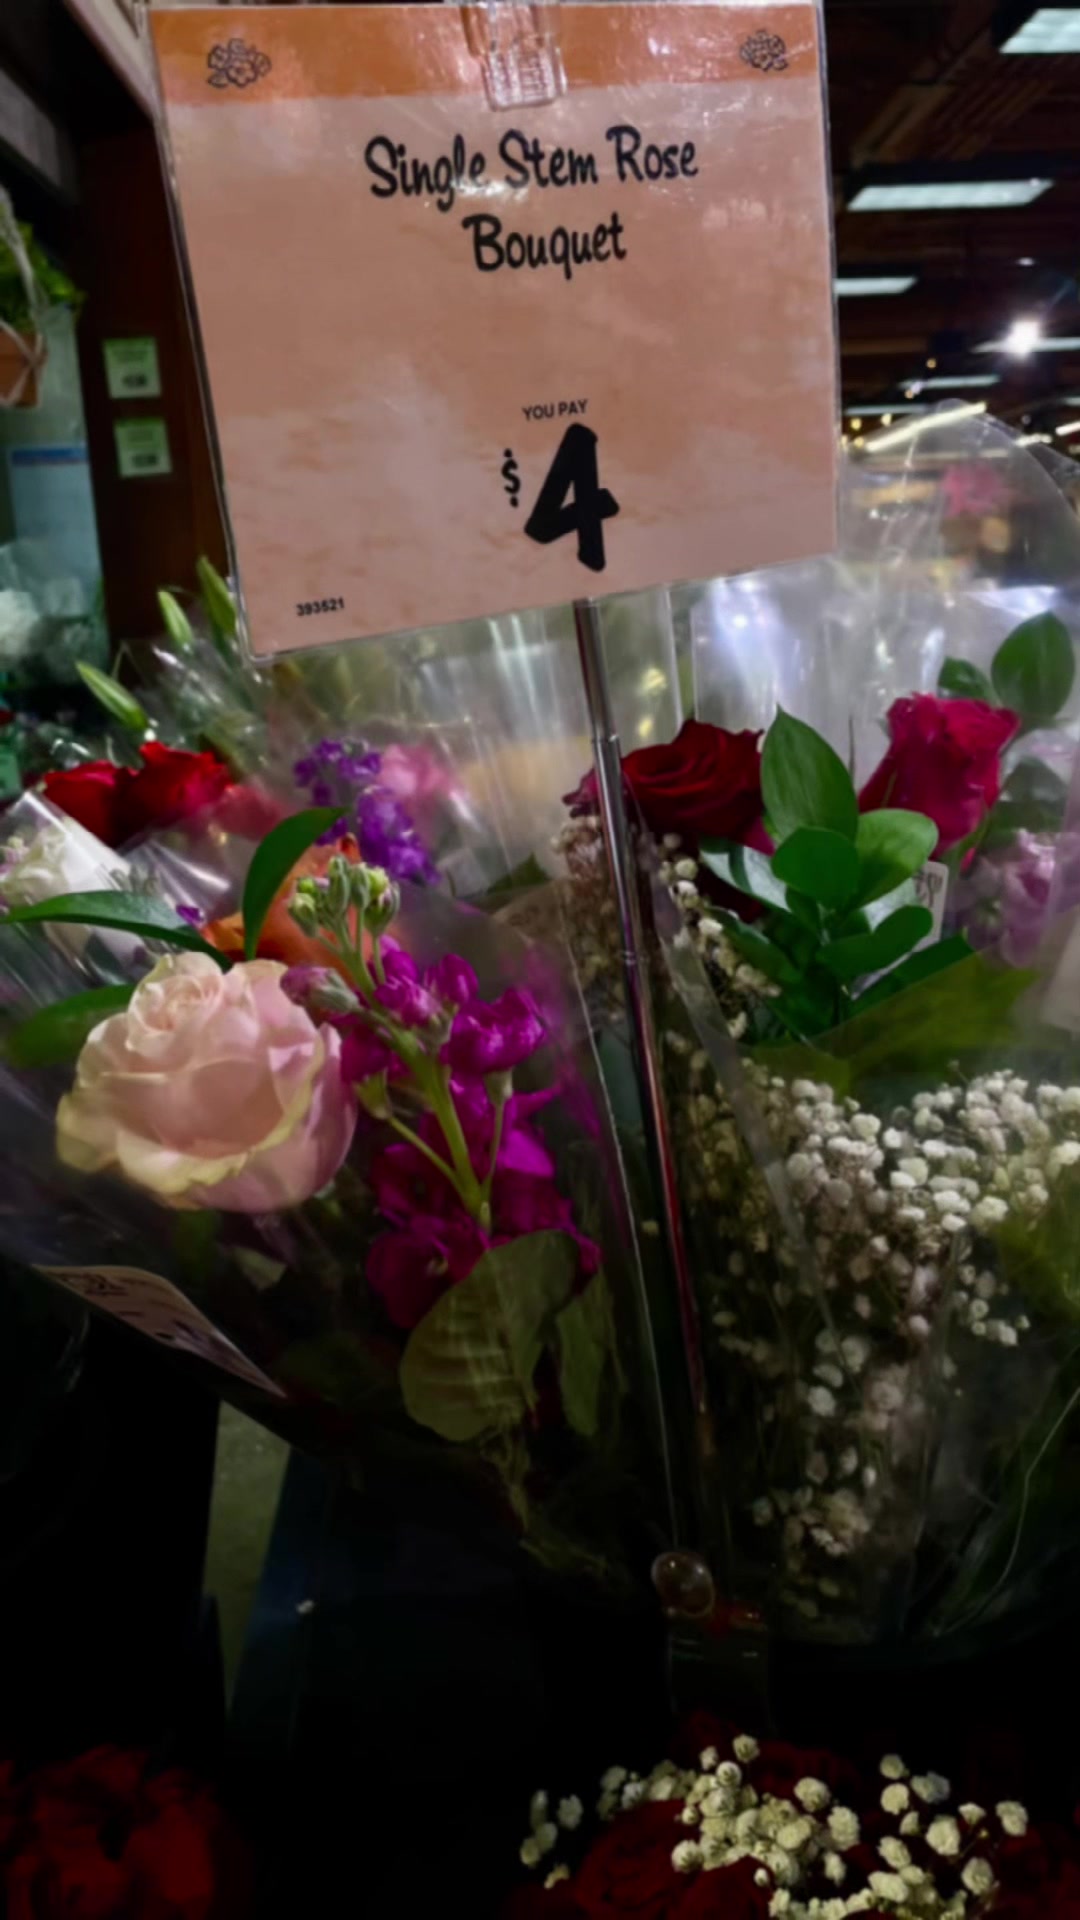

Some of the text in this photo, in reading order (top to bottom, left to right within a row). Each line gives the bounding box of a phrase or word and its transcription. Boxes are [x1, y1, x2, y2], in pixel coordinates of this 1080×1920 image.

[363, 124, 699, 213] Single Stem Rose
[460, 211, 628, 281] Bouquet
[521, 399, 589, 421] YOU PAY
[295, 596, 346, 617] 393521
